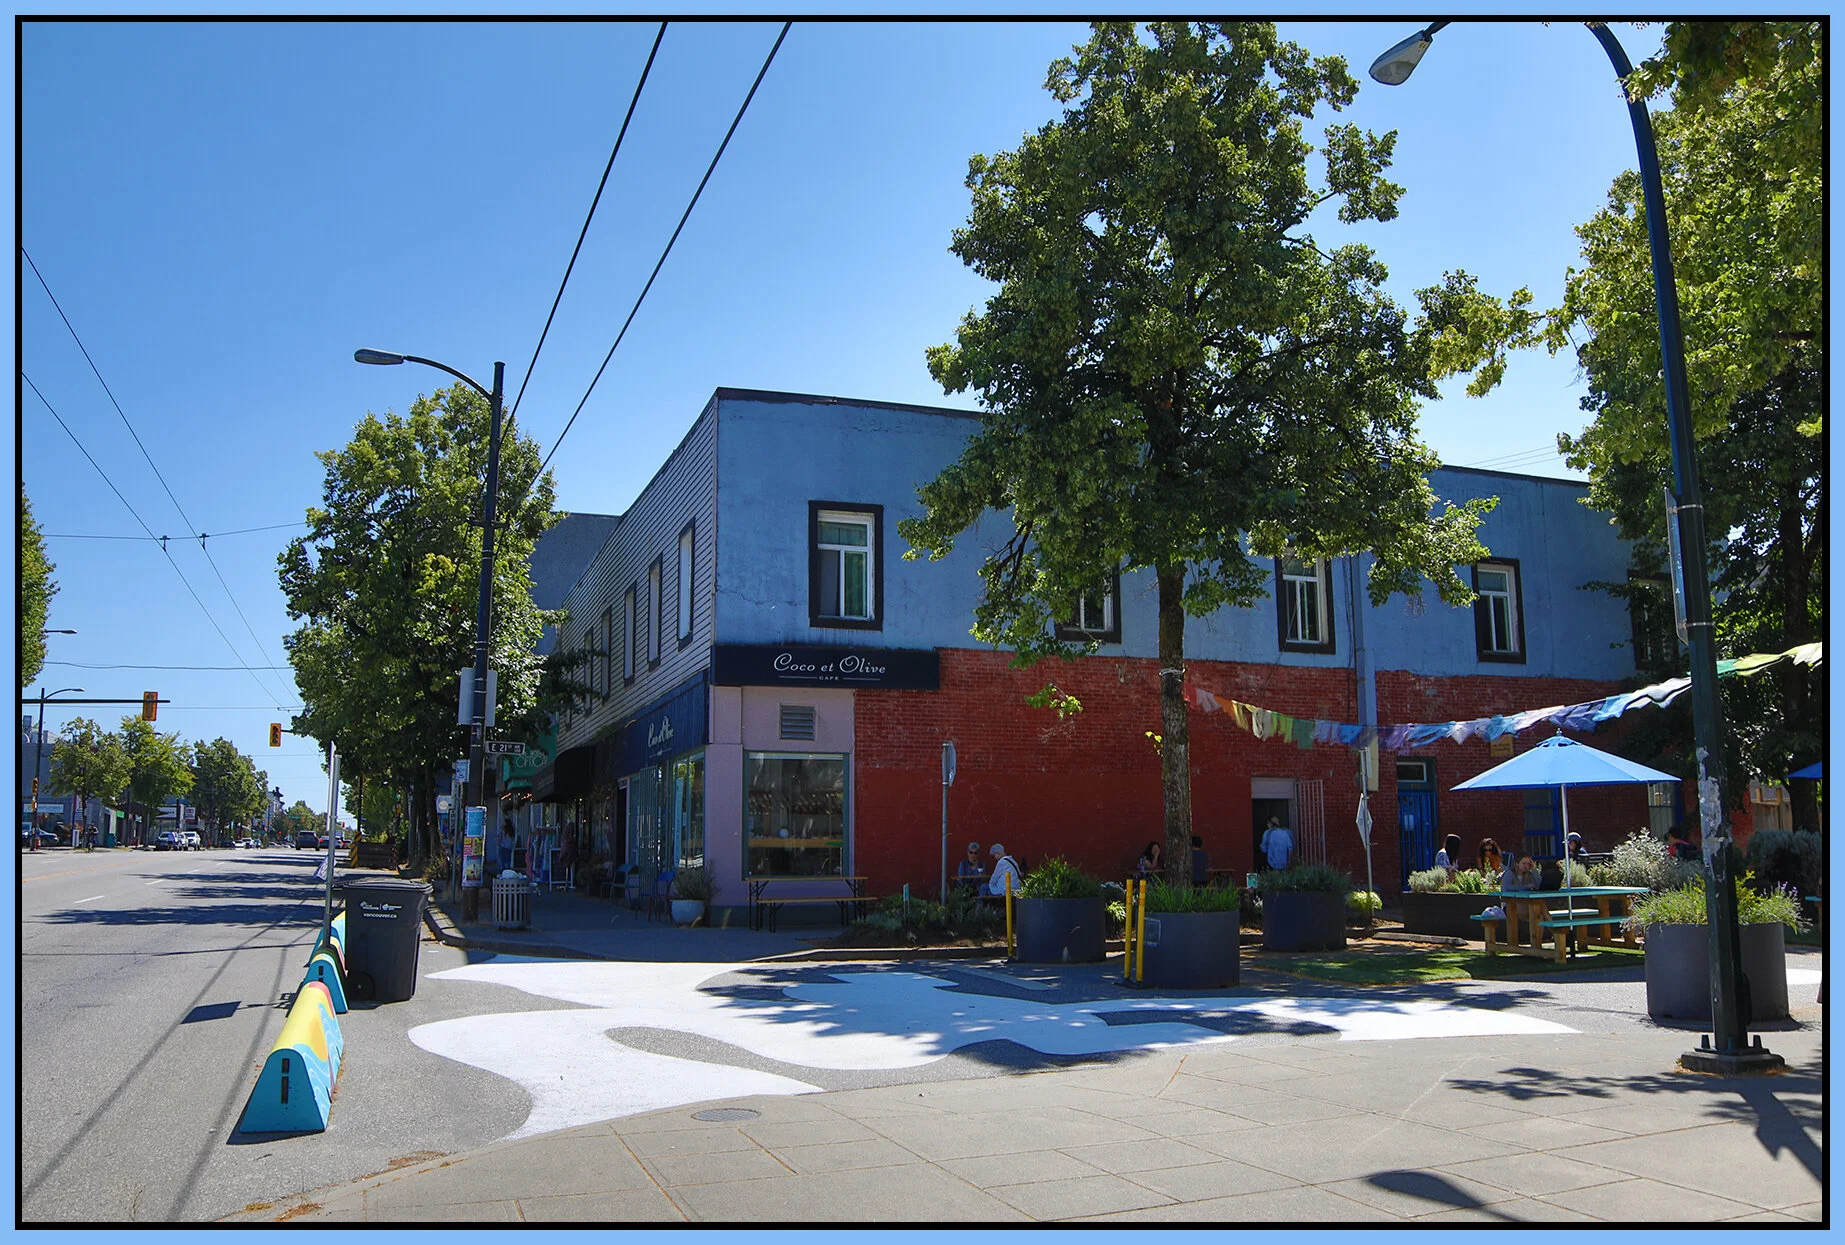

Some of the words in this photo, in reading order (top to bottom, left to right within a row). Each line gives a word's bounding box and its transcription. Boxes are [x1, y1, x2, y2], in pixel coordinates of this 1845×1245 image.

[773, 653, 816, 671] Coco
[820, 663, 834, 672] et
[839, 655, 886, 674] Olive
[491, 743, 497, 752] E
